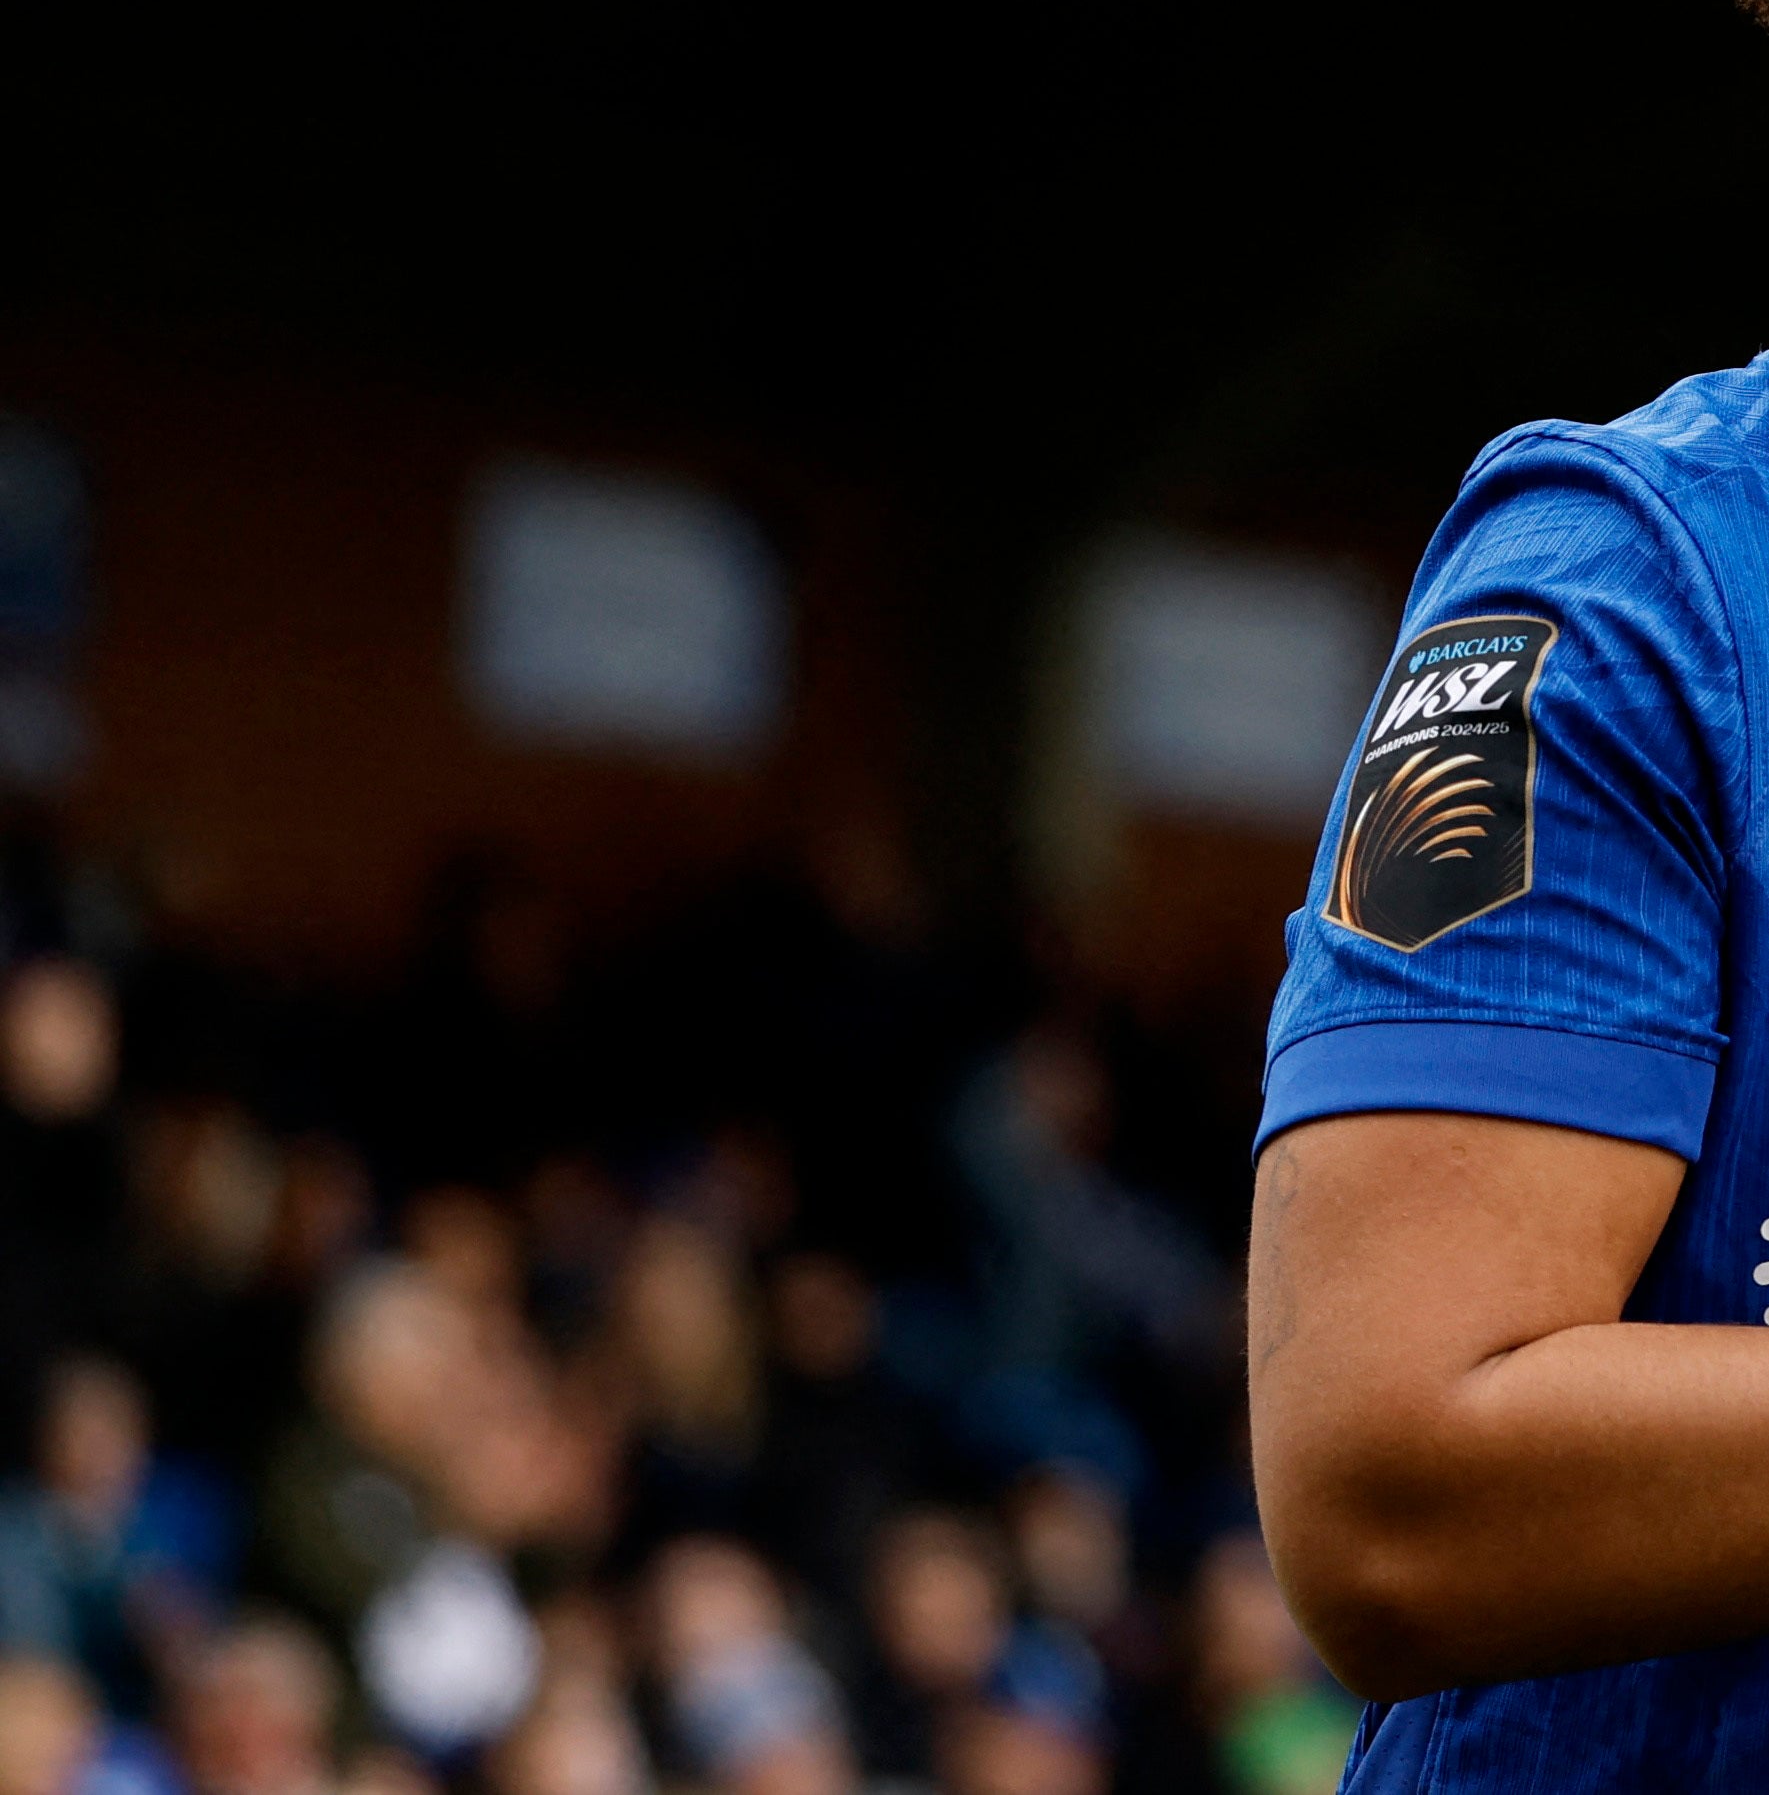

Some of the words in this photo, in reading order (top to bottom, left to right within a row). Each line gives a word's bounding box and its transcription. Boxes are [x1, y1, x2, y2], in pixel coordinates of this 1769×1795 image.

[1425, 635, 1529, 666] BARCLAYS
[1370, 660, 1518, 744] WSL
[1364, 725, 1440, 765] CHAMPIONS
[1440, 720, 1511, 738] 2024/25
